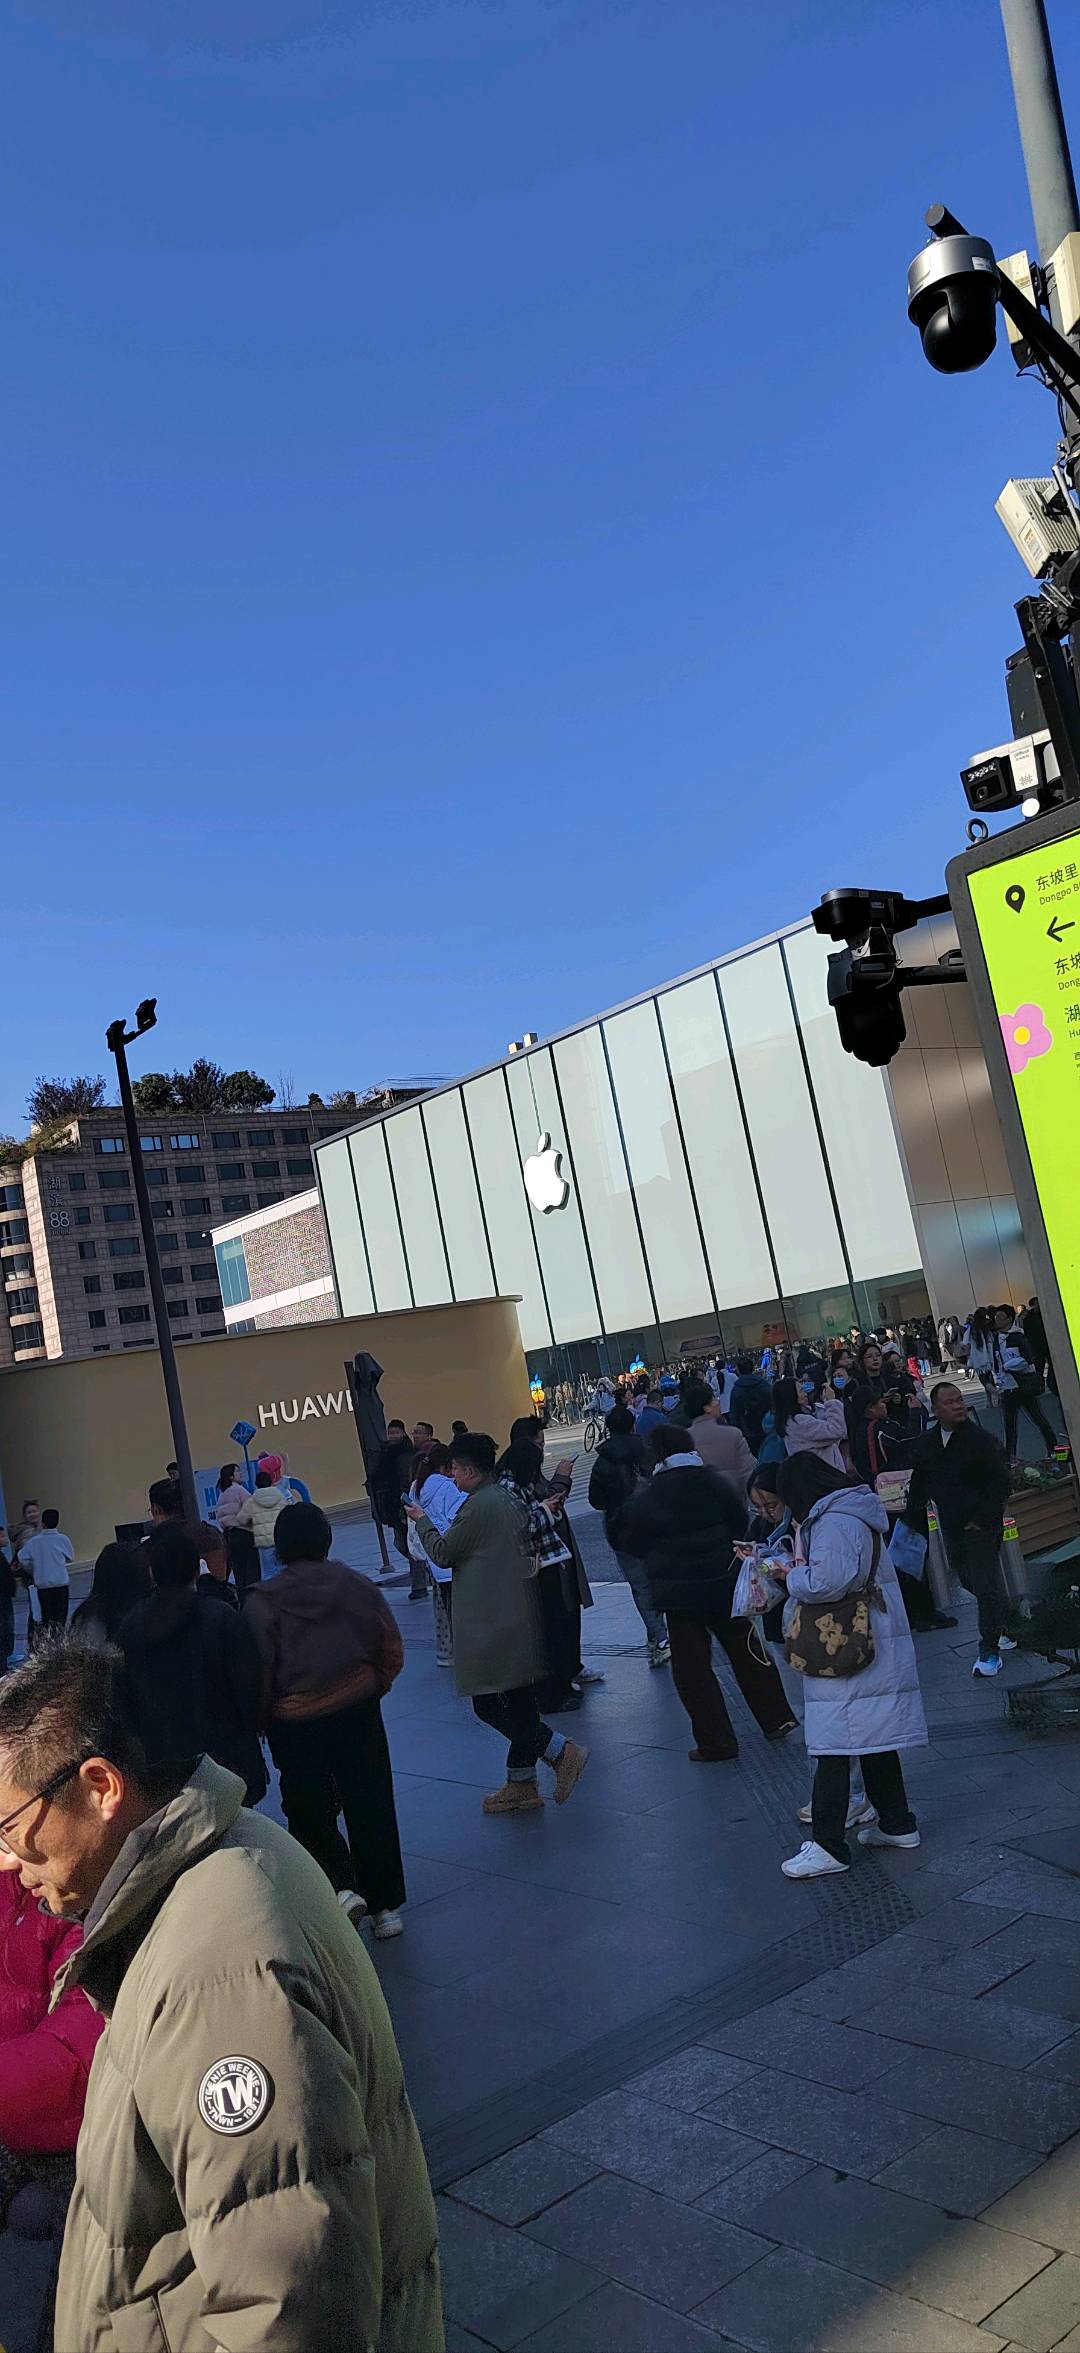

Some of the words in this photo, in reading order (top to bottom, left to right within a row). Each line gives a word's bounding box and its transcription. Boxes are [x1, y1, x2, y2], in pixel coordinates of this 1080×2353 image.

[1036, 863, 1079, 891] 东坡里
[1039, 887, 1072, 905] Dongpo
[1073, 881, 1080, 892] B
[50, 1211, 70, 1228] 88
[258, 1389, 354, 1428] HUAW
[205, 2066, 228, 2103] TEENIE
[227, 2063, 260, 2088] WEENIE
[212, 2069, 253, 2116] TW
